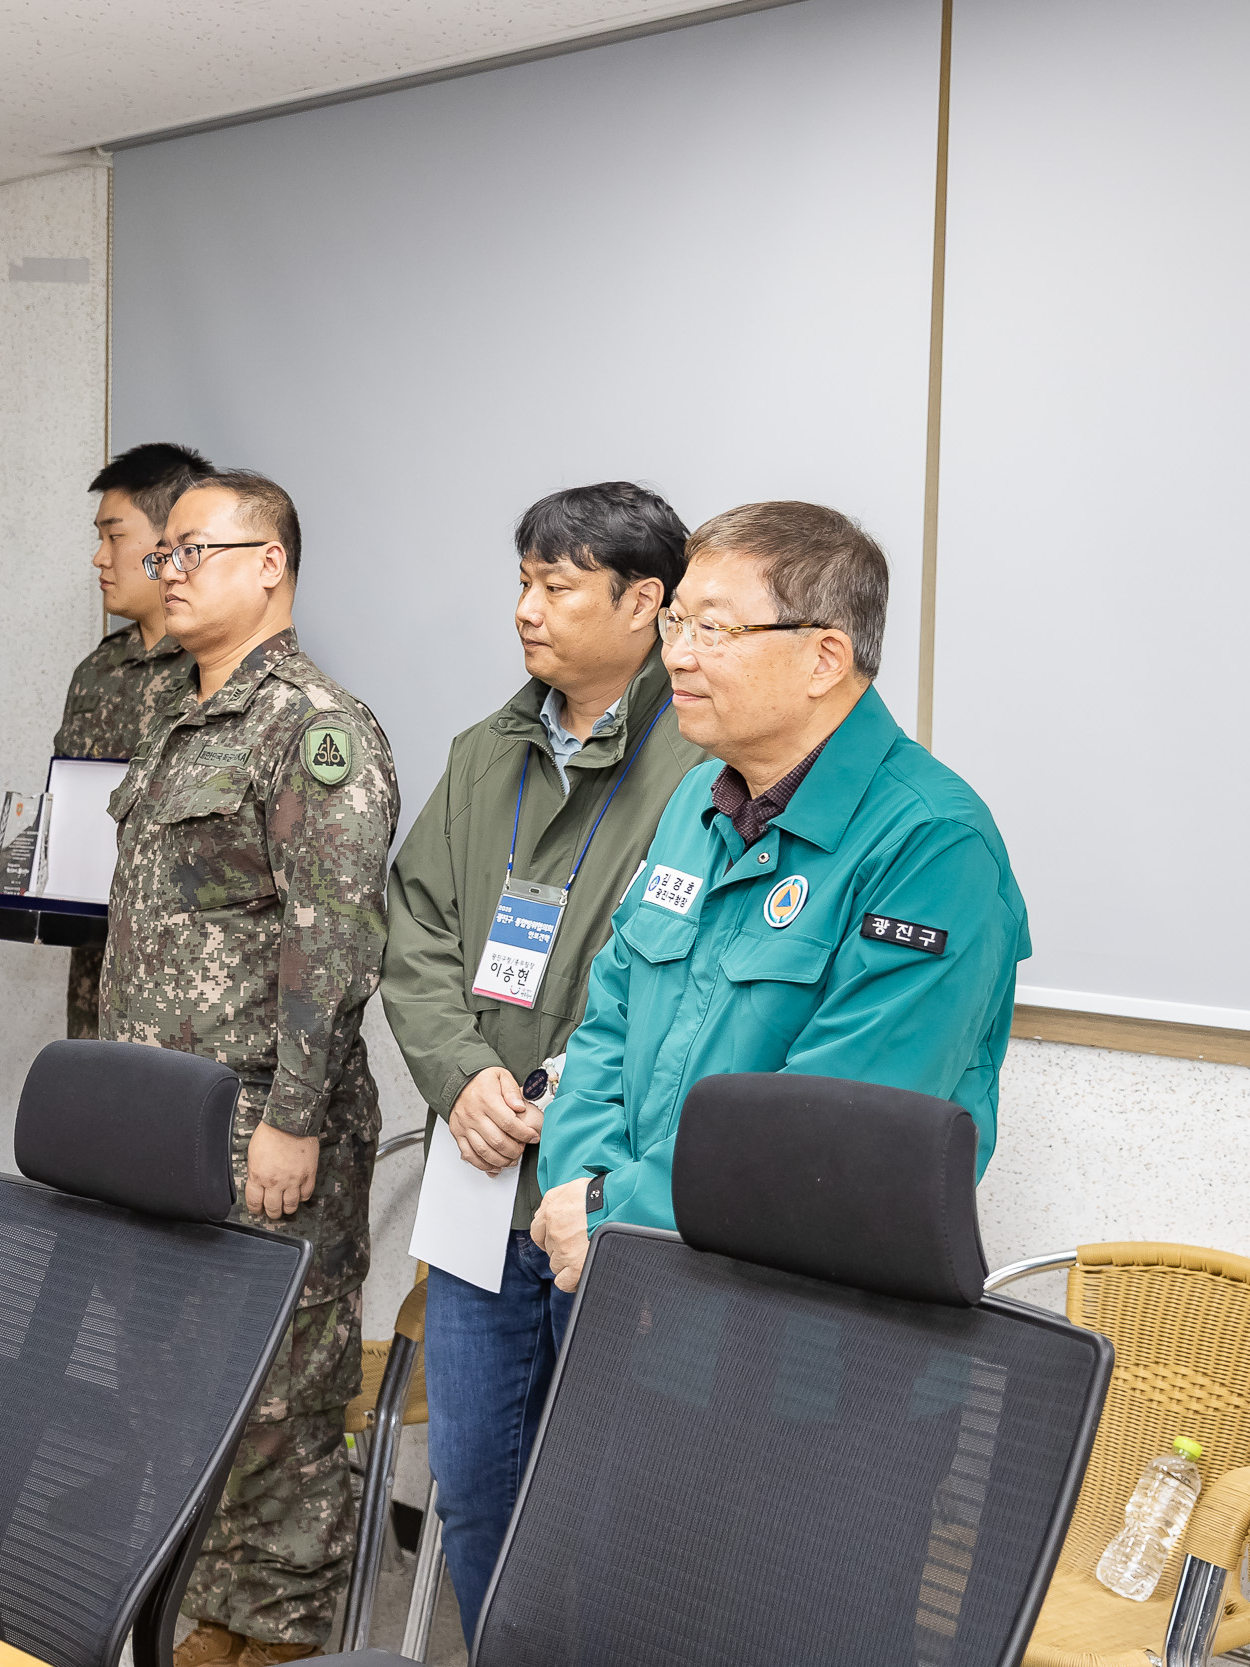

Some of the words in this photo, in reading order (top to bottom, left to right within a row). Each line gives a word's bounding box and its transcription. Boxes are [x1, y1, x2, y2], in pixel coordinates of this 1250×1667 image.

[655, 888, 688, 908] 광진구청장
[872, 917, 937, 947] 광진구
[490, 962, 530, 986] 이승현
